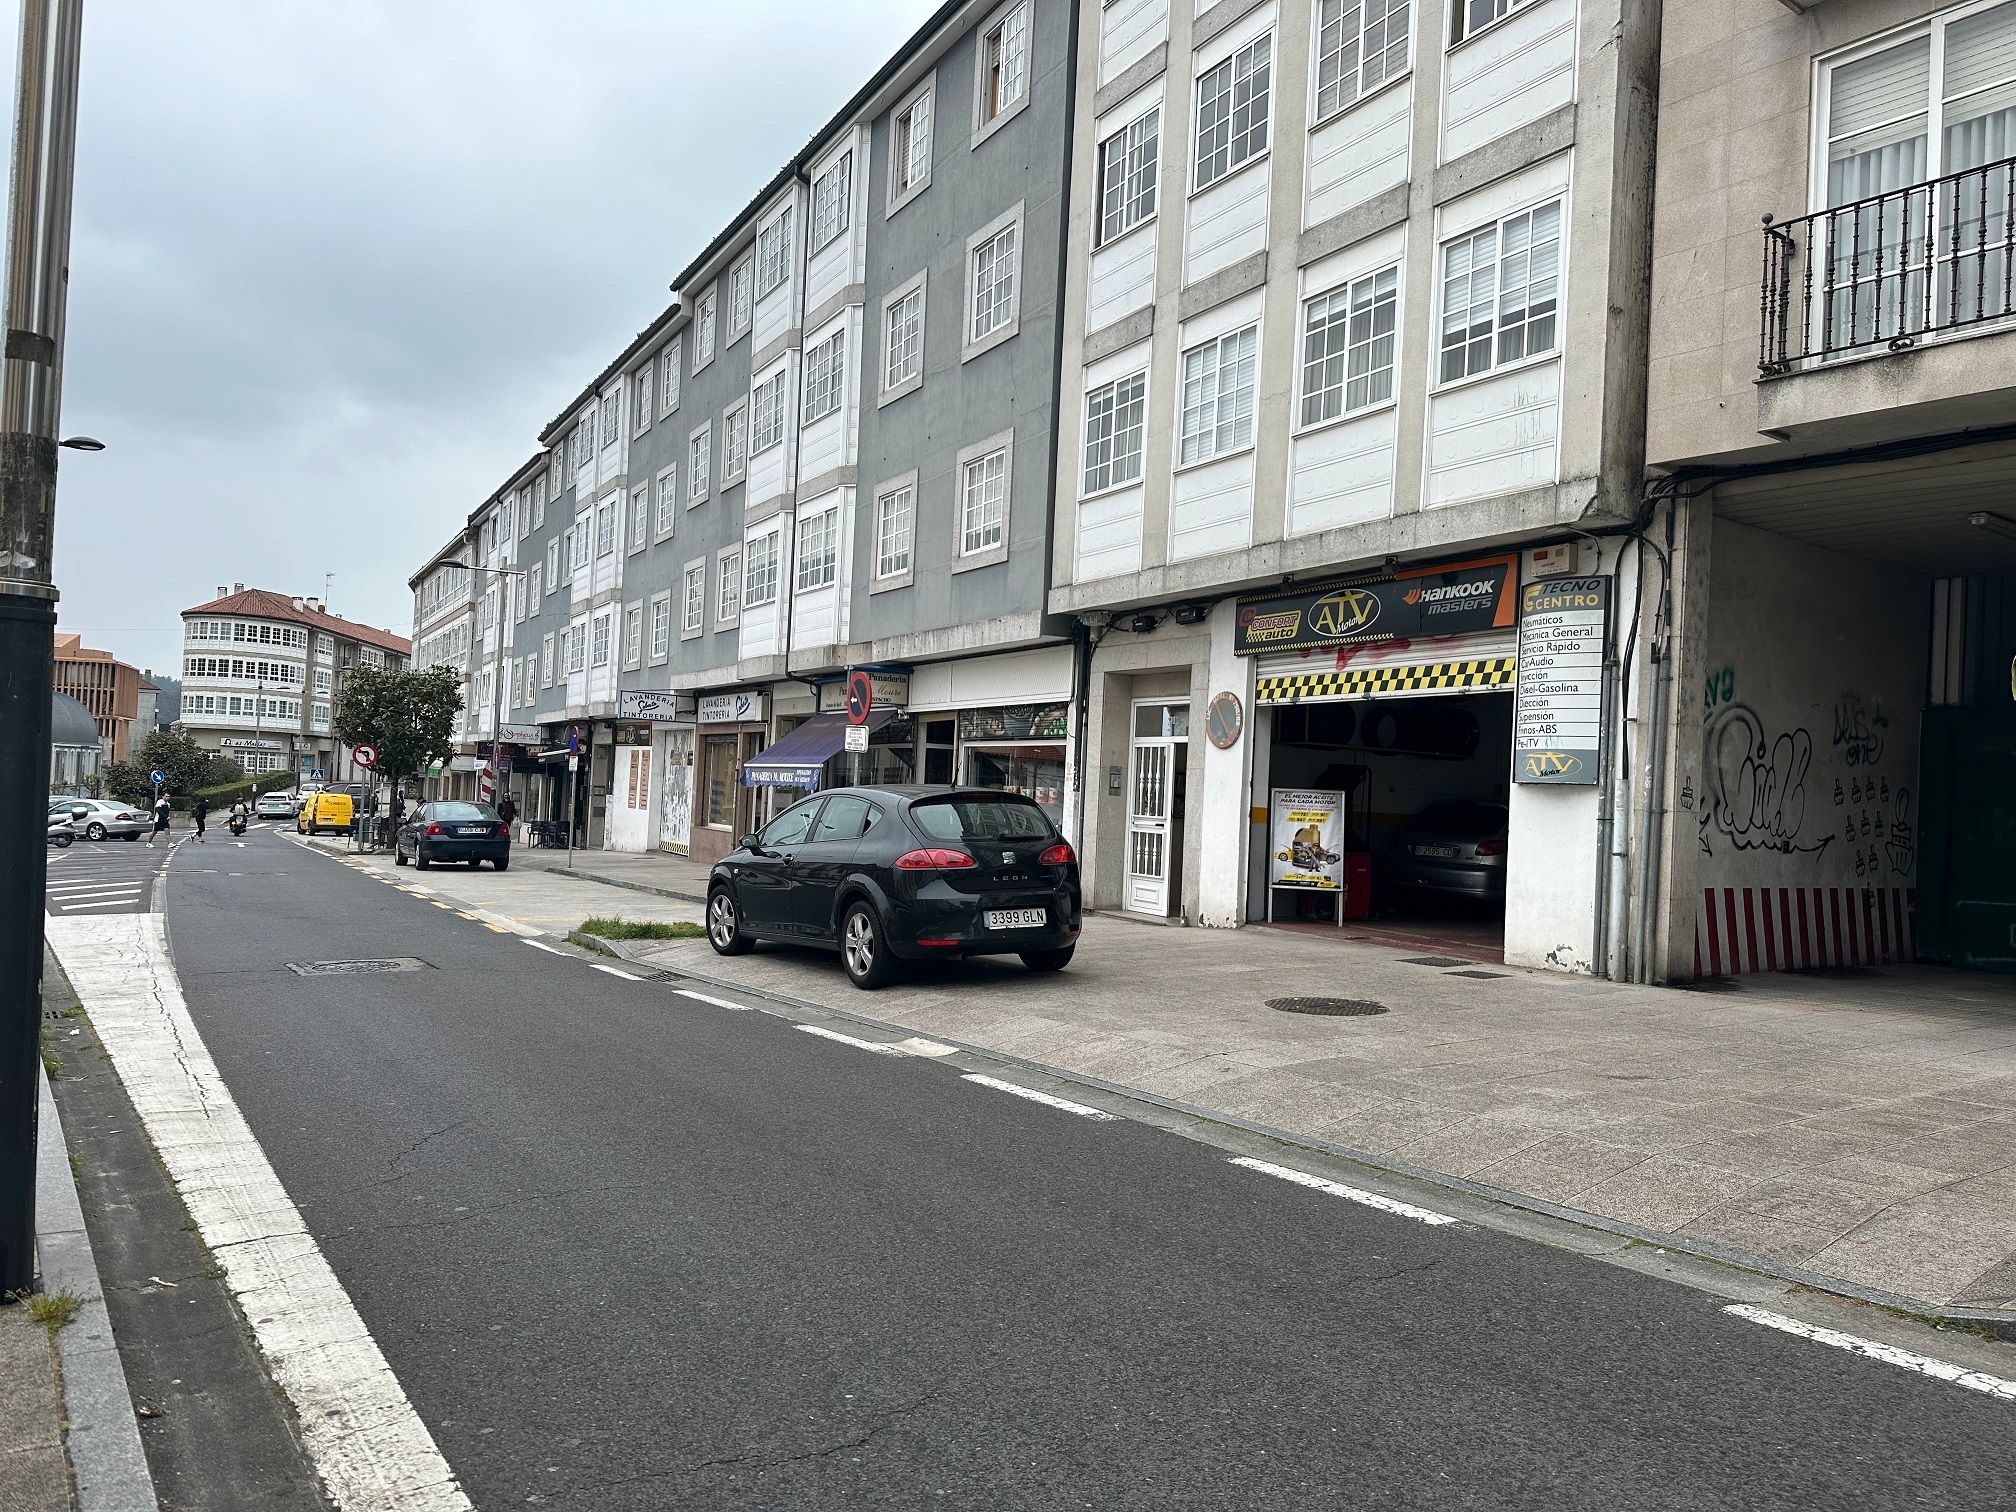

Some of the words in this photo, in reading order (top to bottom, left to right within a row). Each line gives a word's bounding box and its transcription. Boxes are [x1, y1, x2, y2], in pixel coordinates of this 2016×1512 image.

[1542, 580, 1601, 595] TECNO
[1428, 597, 1494, 615] masters
[1535, 594, 1599, 610] CENTRO
[1250, 613, 1298, 631] CONFORT
[1335, 616, 1359, 635] Motor
[1522, 616, 1563, 628] Neumáticos
[1264, 628, 1294, 640] auto
[1522, 630, 1549, 642] Mecánica
[1552, 626, 1593, 638] General
[1521, 644, 1544, 655] Servicio
[1546, 641, 1581, 654] Rápido
[623, 694, 675, 708] LAVANDERIA
[703, 697, 731, 709] LAVANDERIA
[623, 711, 673, 720] TINTORERIA
[703, 709, 730, 720] TINTORERIA
[1539, 769, 1562, 777] Motor
[991, 911, 1020, 925] 3399
[1022, 910, 1044, 923] GLN
